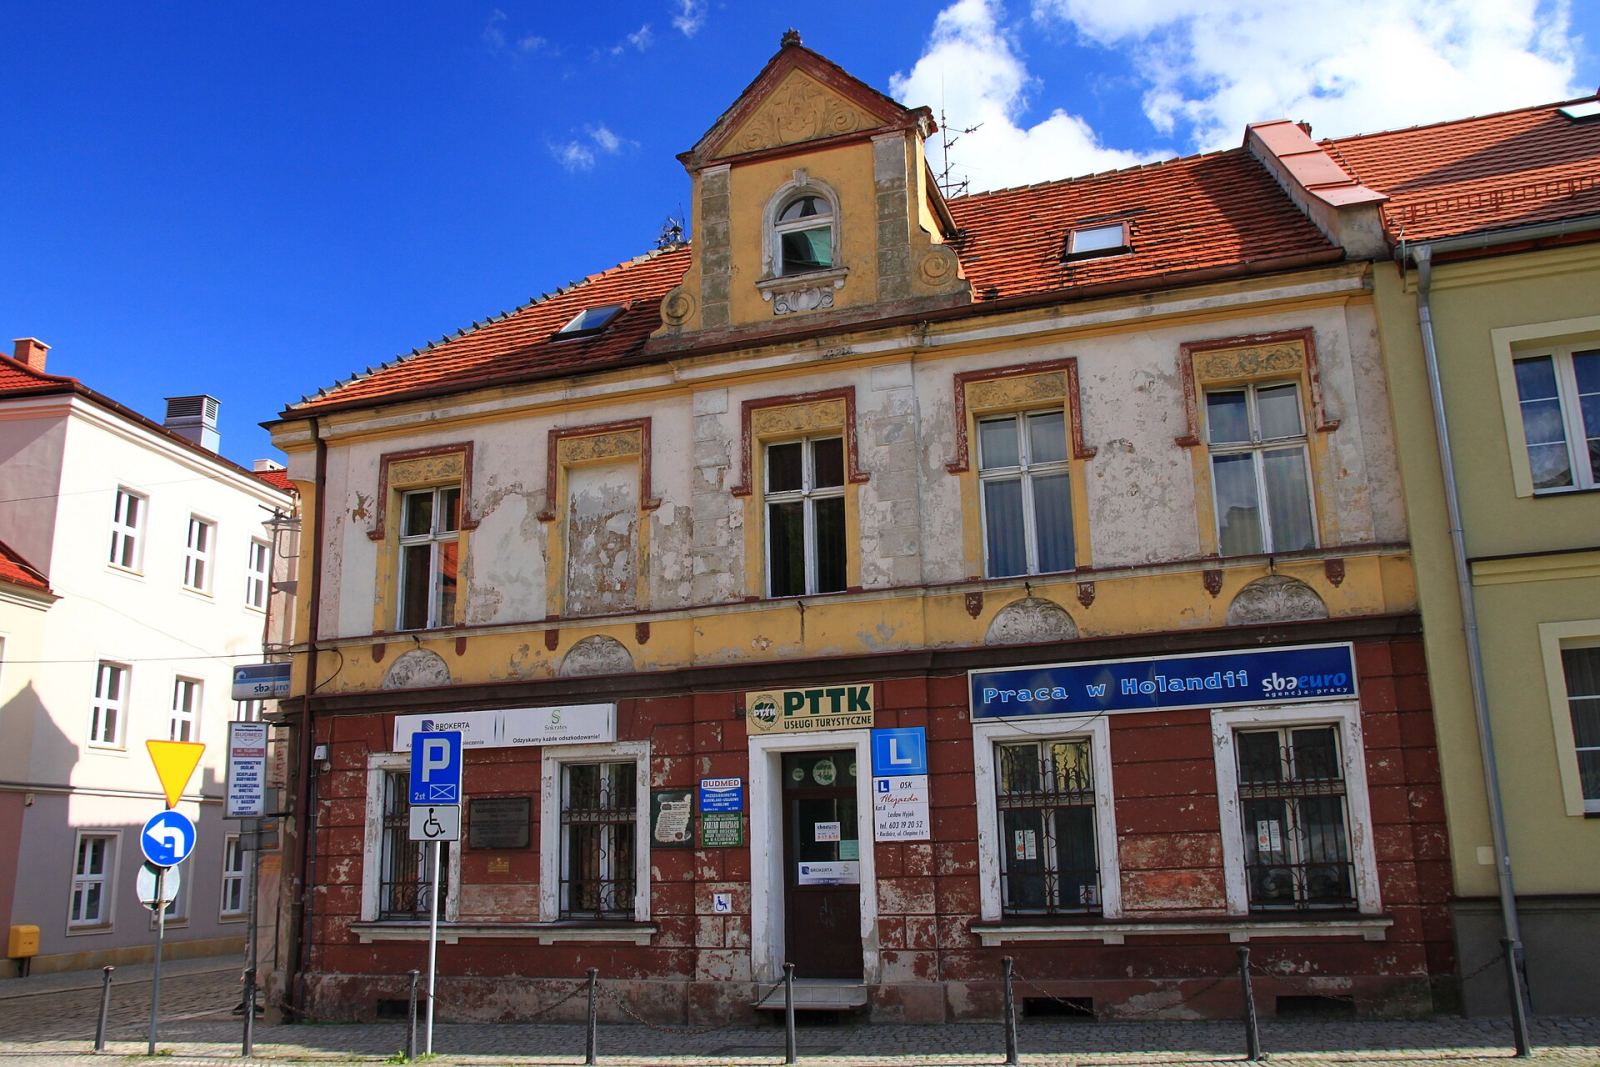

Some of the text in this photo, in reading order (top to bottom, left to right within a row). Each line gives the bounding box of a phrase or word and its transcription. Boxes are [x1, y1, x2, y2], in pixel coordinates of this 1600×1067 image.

[983, 669, 1249, 704] Praca w Holandii
[1316, 687, 1348, 695] pracy
[784, 686, 871, 716] PTTK
[753, 707, 776, 717] PTTK
[435, 722, 470, 730] BROKERTA
[784, 715, 872, 730] USŁUGI TURYSTYCZNE
[512, 736, 541, 744] Odzyskamy
[558, 733, 601, 741] odszkodowanie!
[889, 738, 912, 764] L
[421, 738, 451, 782] P
[880, 781, 912, 791] L OSK
[414, 791, 426, 801] 2st
[889, 821, 899, 829] 603
